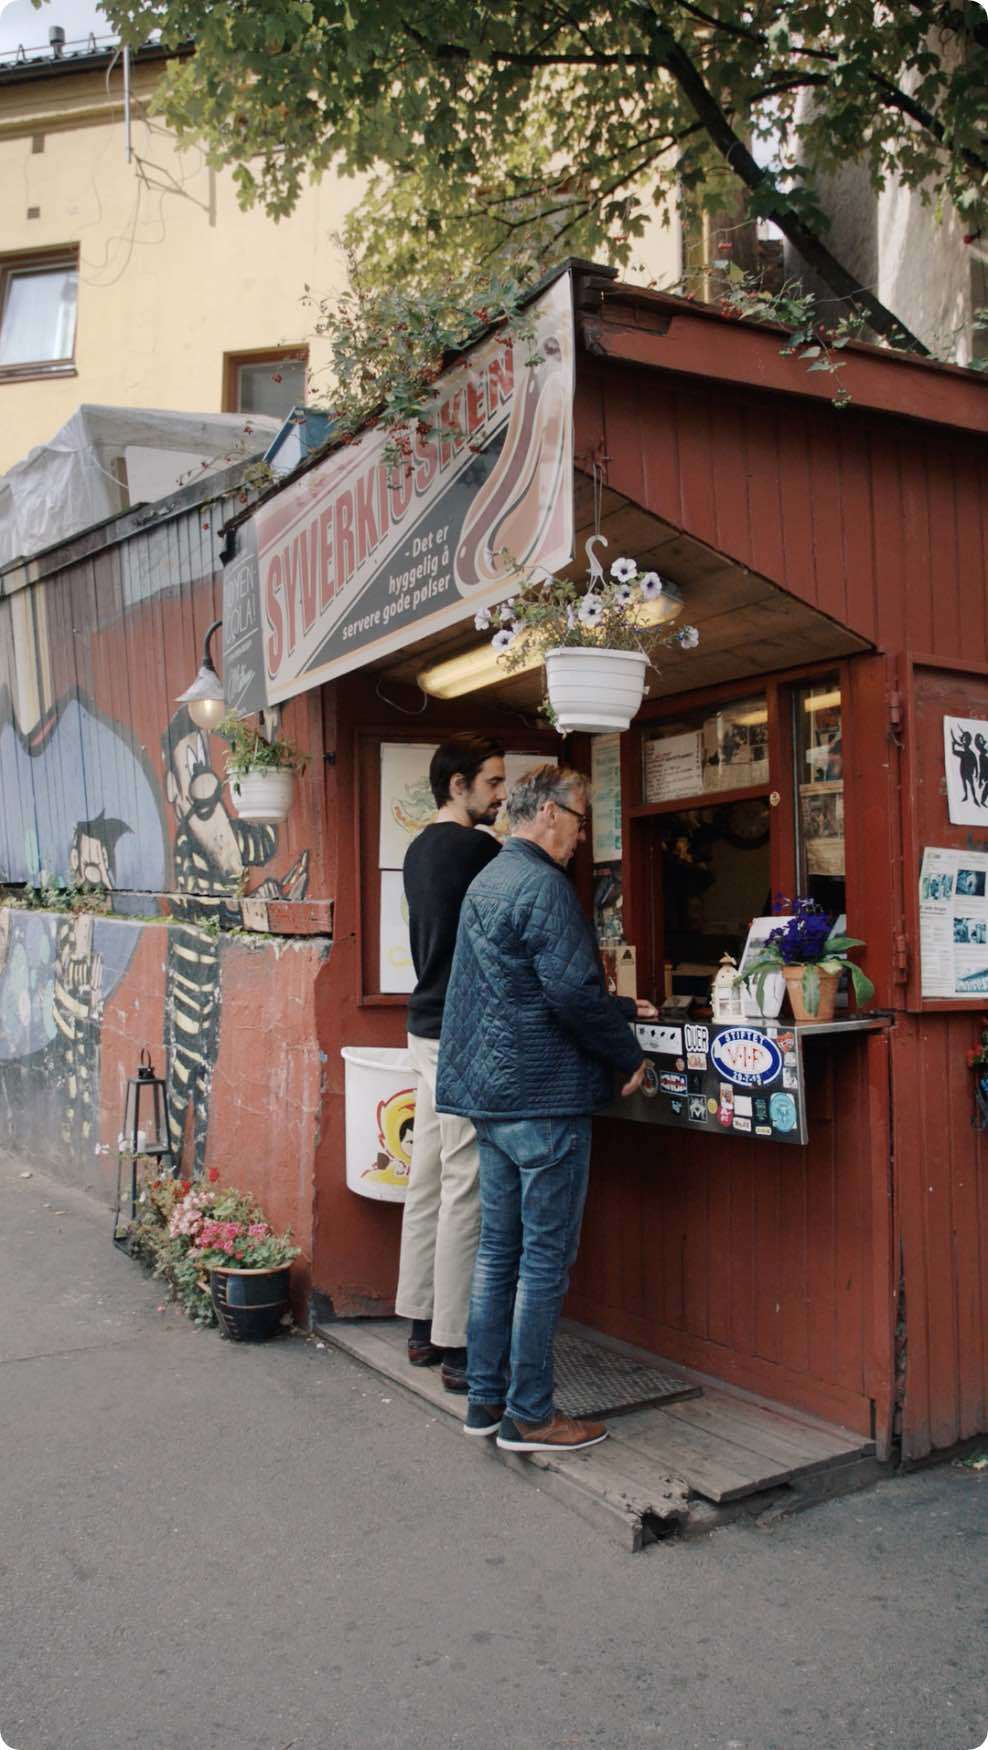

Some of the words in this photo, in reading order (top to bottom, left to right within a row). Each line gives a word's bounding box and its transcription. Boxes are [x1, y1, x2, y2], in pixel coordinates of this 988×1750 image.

[265, 348, 514, 680] SYVERKIOSKEN
[412, 532, 434, 558] Det
[436, 525, 449, 543] er
[388, 554, 438, 595] hyggelig
[442, 545, 449, 566] å
[343, 610, 381, 640] servere
[383, 593, 411, 625] gode
[412, 573, 451, 610] pølser
